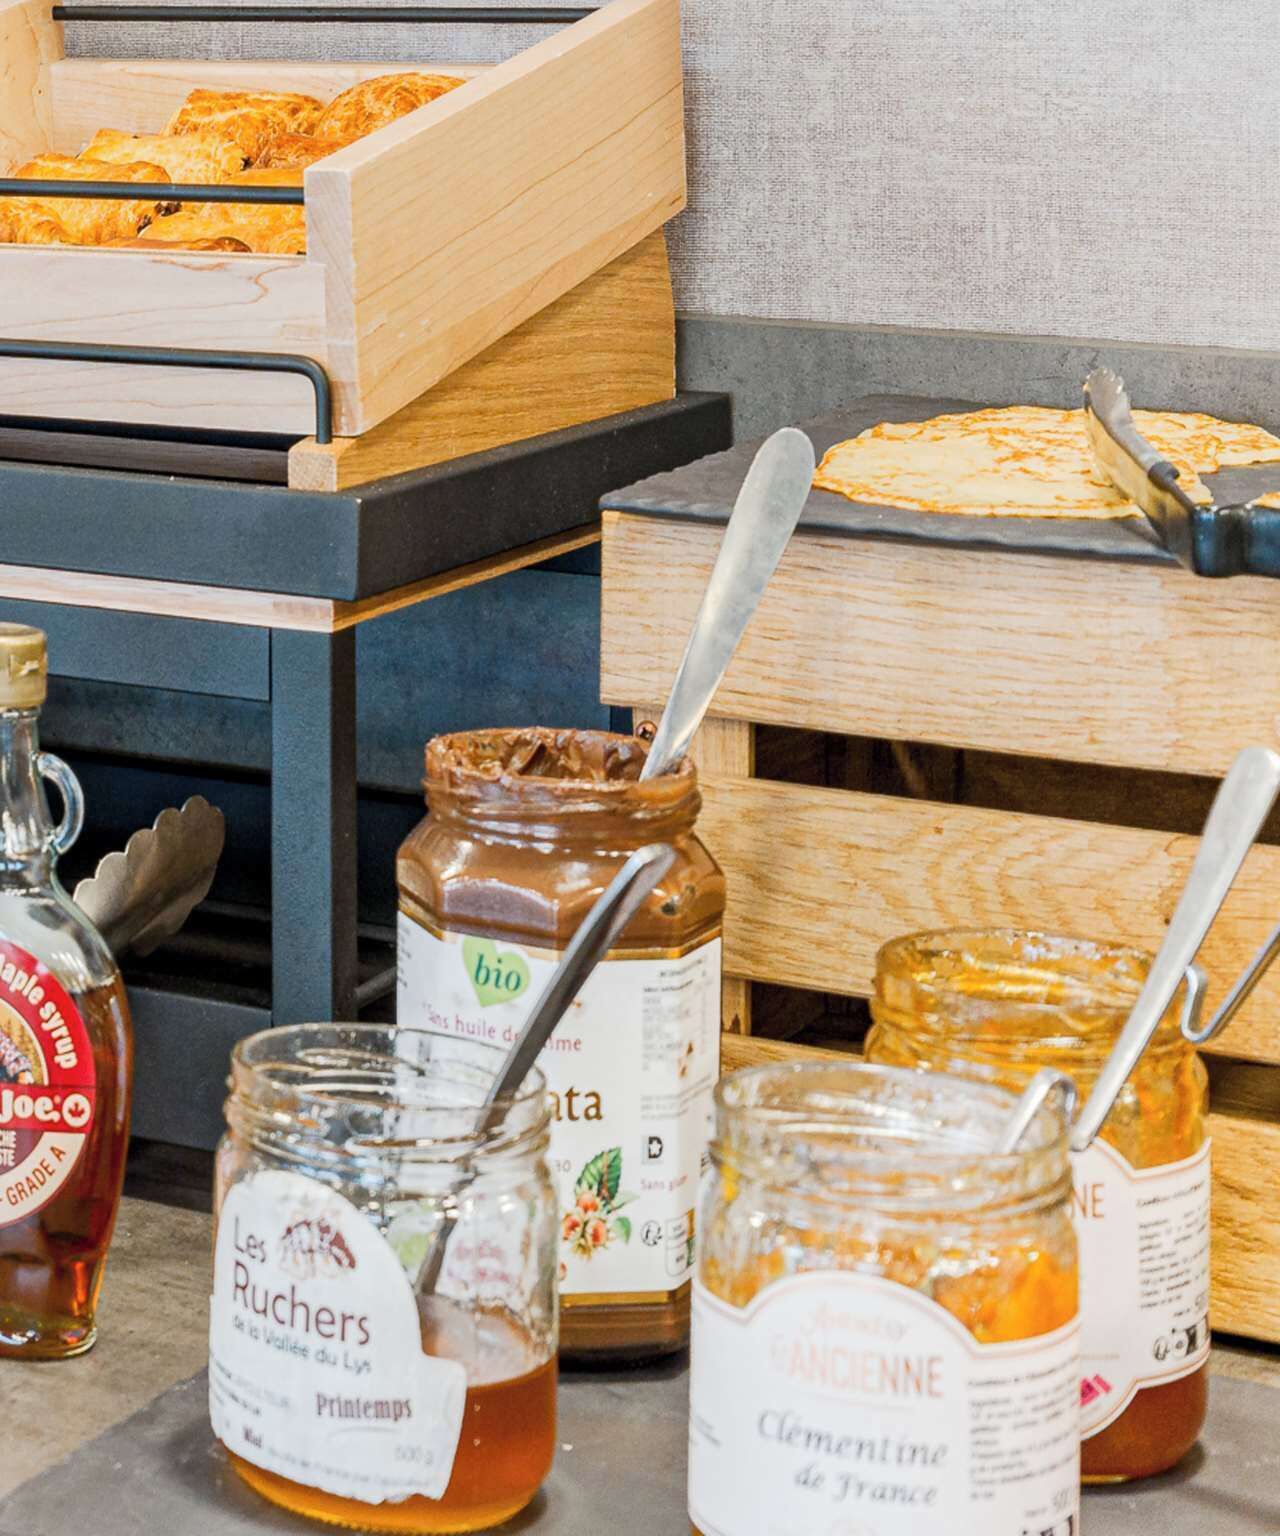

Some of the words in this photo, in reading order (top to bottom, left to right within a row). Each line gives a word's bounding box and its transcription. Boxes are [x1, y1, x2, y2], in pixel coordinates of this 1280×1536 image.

[474, 952, 521, 993] bio
[39, 1001, 78, 1070] syrup
[455, 1014, 496, 1040] huile
[5, 1156, 55, 1207] GRADE
[56, 1144, 67, 1163] A
[234, 1216, 266, 1263] Les
[233, 1260, 371, 1346] Ruchers
[314, 1348, 338, 1368] du
[315, 1391, 413, 1422] Printemps
[757, 1409, 950, 1468] Clémentine
[793, 1462, 826, 1490] de
[832, 1470, 940, 1507] France
